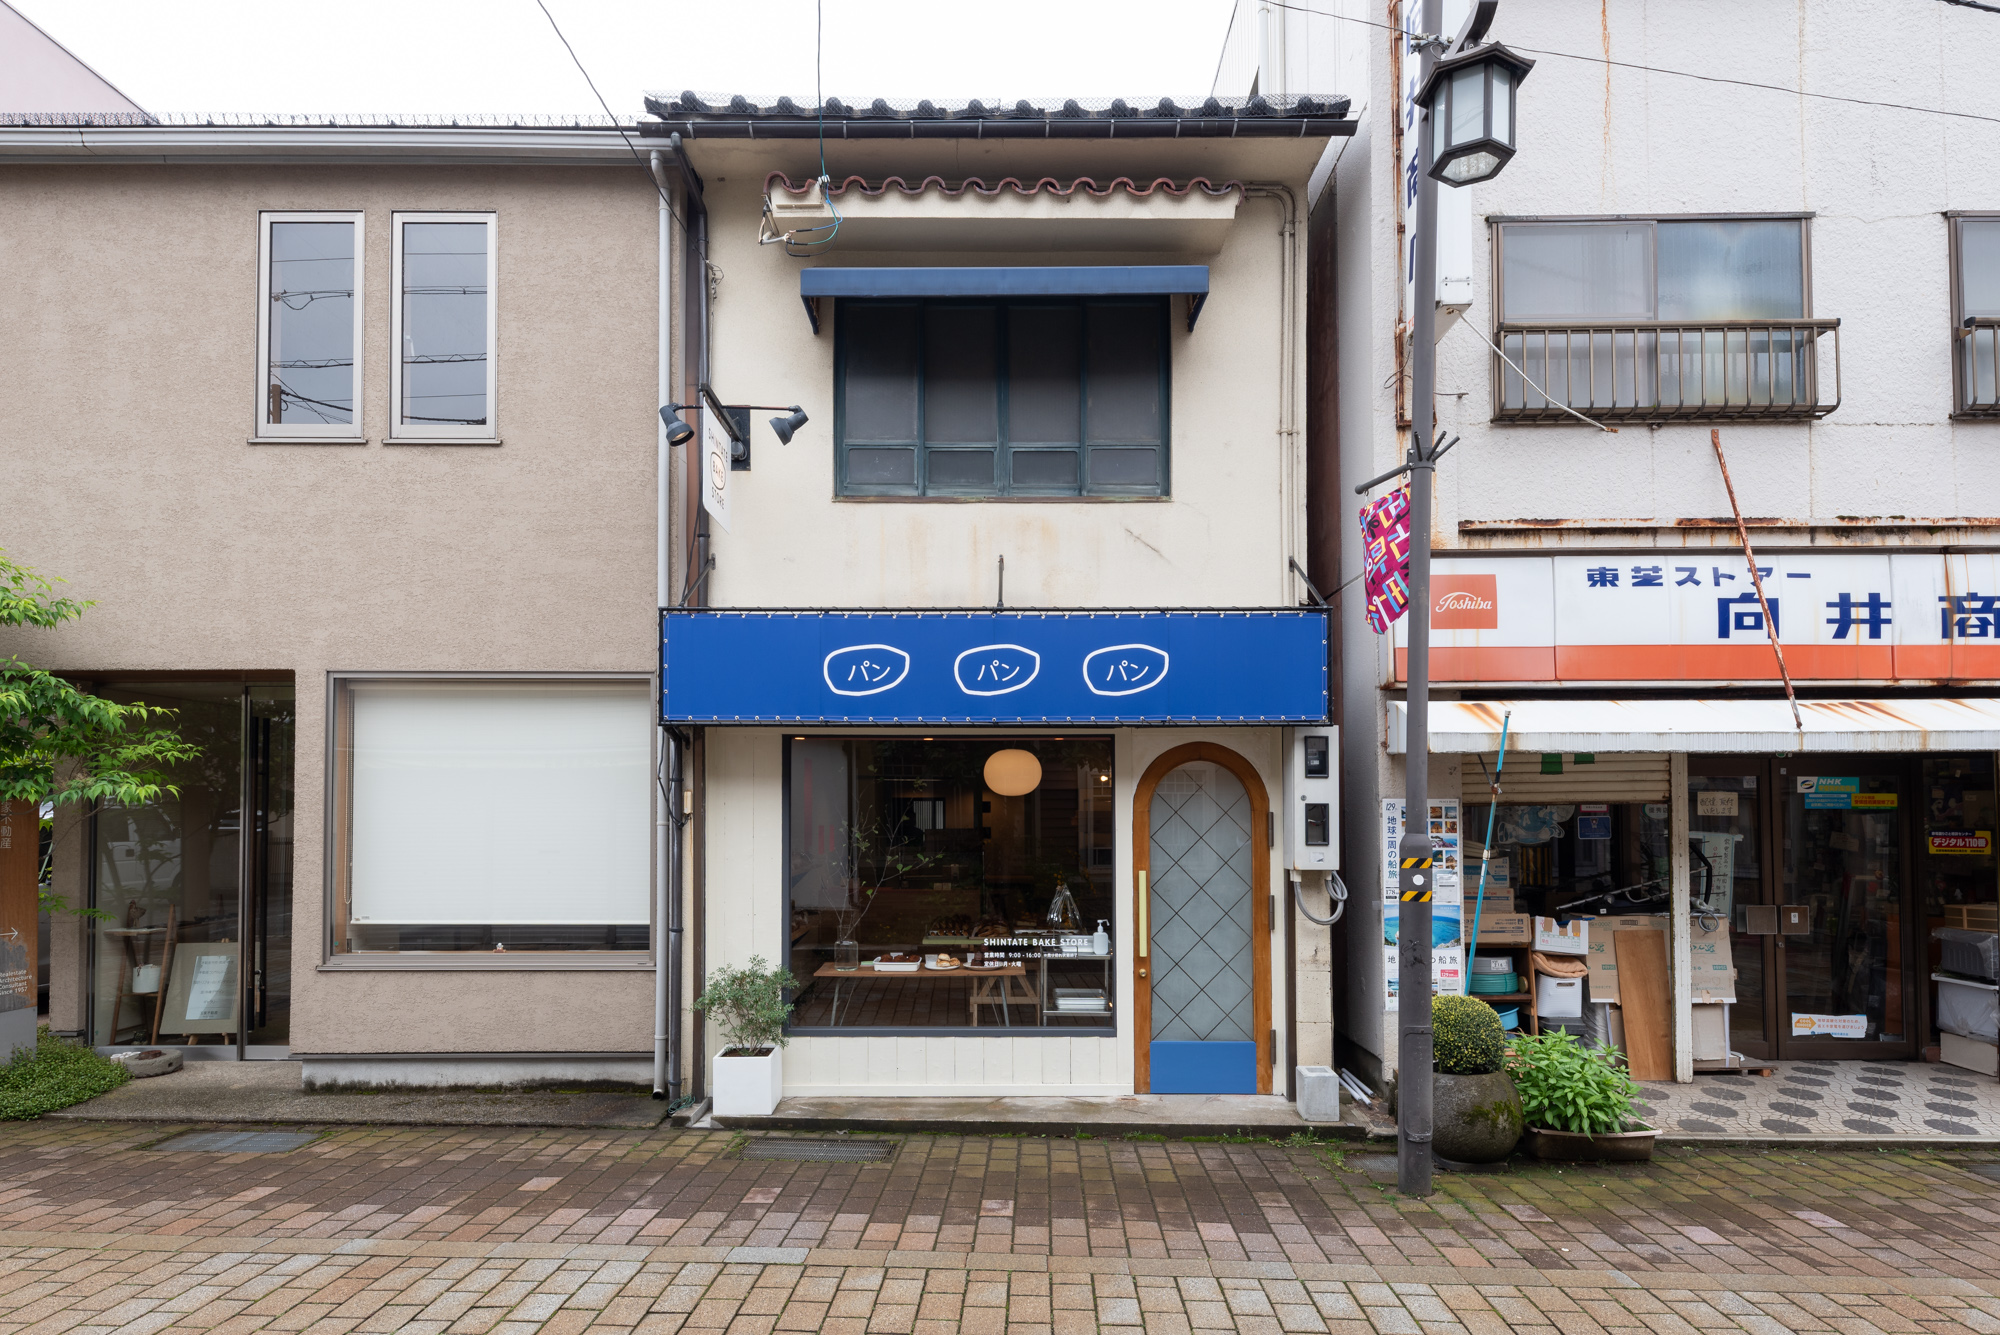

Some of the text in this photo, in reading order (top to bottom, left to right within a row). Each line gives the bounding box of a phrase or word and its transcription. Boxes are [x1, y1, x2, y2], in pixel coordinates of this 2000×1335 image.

[712, 460, 725, 483] BAKE
[711, 486, 726, 510] STORE
[1586, 565, 1812, 588] 東芝ストアー
[1435, 591, 1493, 613] Toshiba
[848, 659, 891, 682] パン
[977, 659, 1020, 682] パン
[1106, 659, 1149, 682] パン
[1385, 802, 1396, 811] 129
[1387, 815, 1398, 879] 地球一周の船旅
[1933, 837, 1987, 848] デジタル110番
[983, 938, 1088, 946] SHINTATE BAKE STORE
